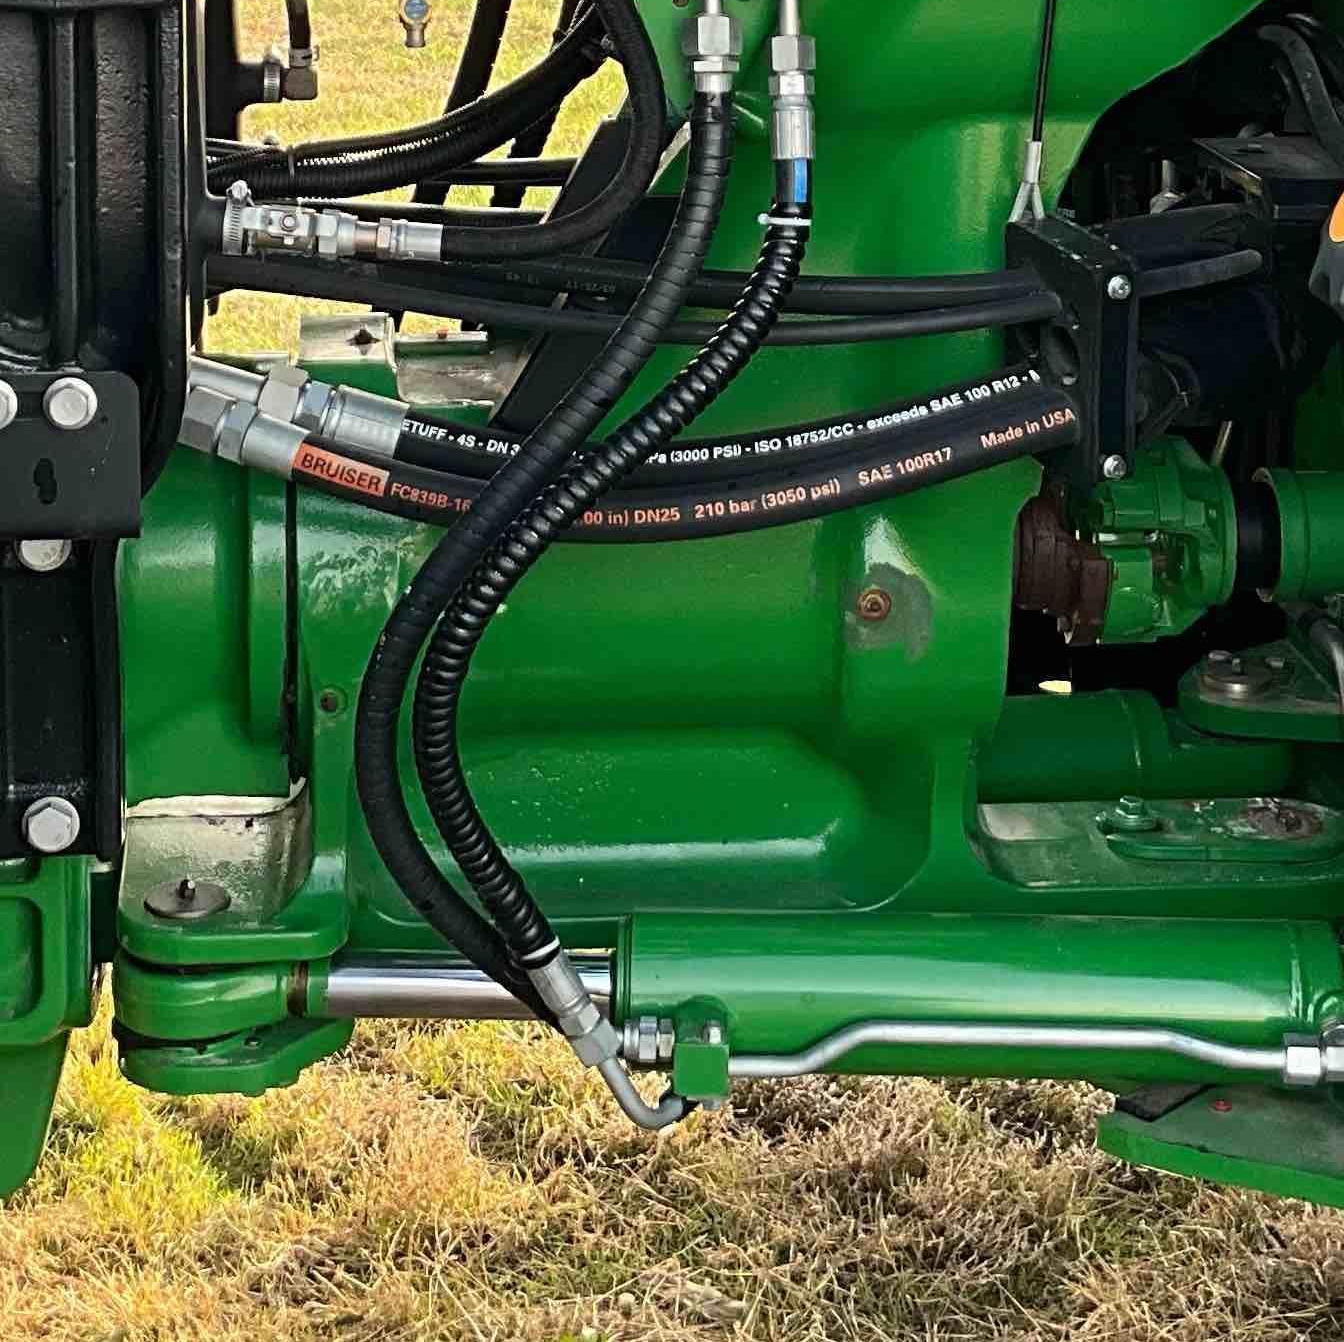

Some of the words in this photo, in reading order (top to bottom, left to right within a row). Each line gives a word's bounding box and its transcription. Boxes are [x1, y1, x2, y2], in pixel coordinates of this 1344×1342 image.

[457, 433, 476, 447] 4S
[486, 439, 508, 455] DN
[670, 447, 709, 463] (3000
[754, 438, 782, 454] ISO
[785, 422, 854, 448] 18752/CC
[867, 404, 929, 430] exceeds
[929, 393, 963, 412] SAE
[965, 384, 991, 403] 100
[992, 375, 1021, 394] R12
[301, 453, 382, 492] BRUISER
[634, 506, 681, 524] DN25
[694, 504, 725, 519] 210
[729, 498, 757, 514] bar
[761, 486, 806, 511] (3050
[810, 477, 841, 501] psi)
[857, 464, 894, 487] SAE
[896, 446, 953, 476] 100R17
[980, 425, 1023, 449] Made
[1024, 420, 1041, 435] in
[1042, 407, 1076, 429] USA
